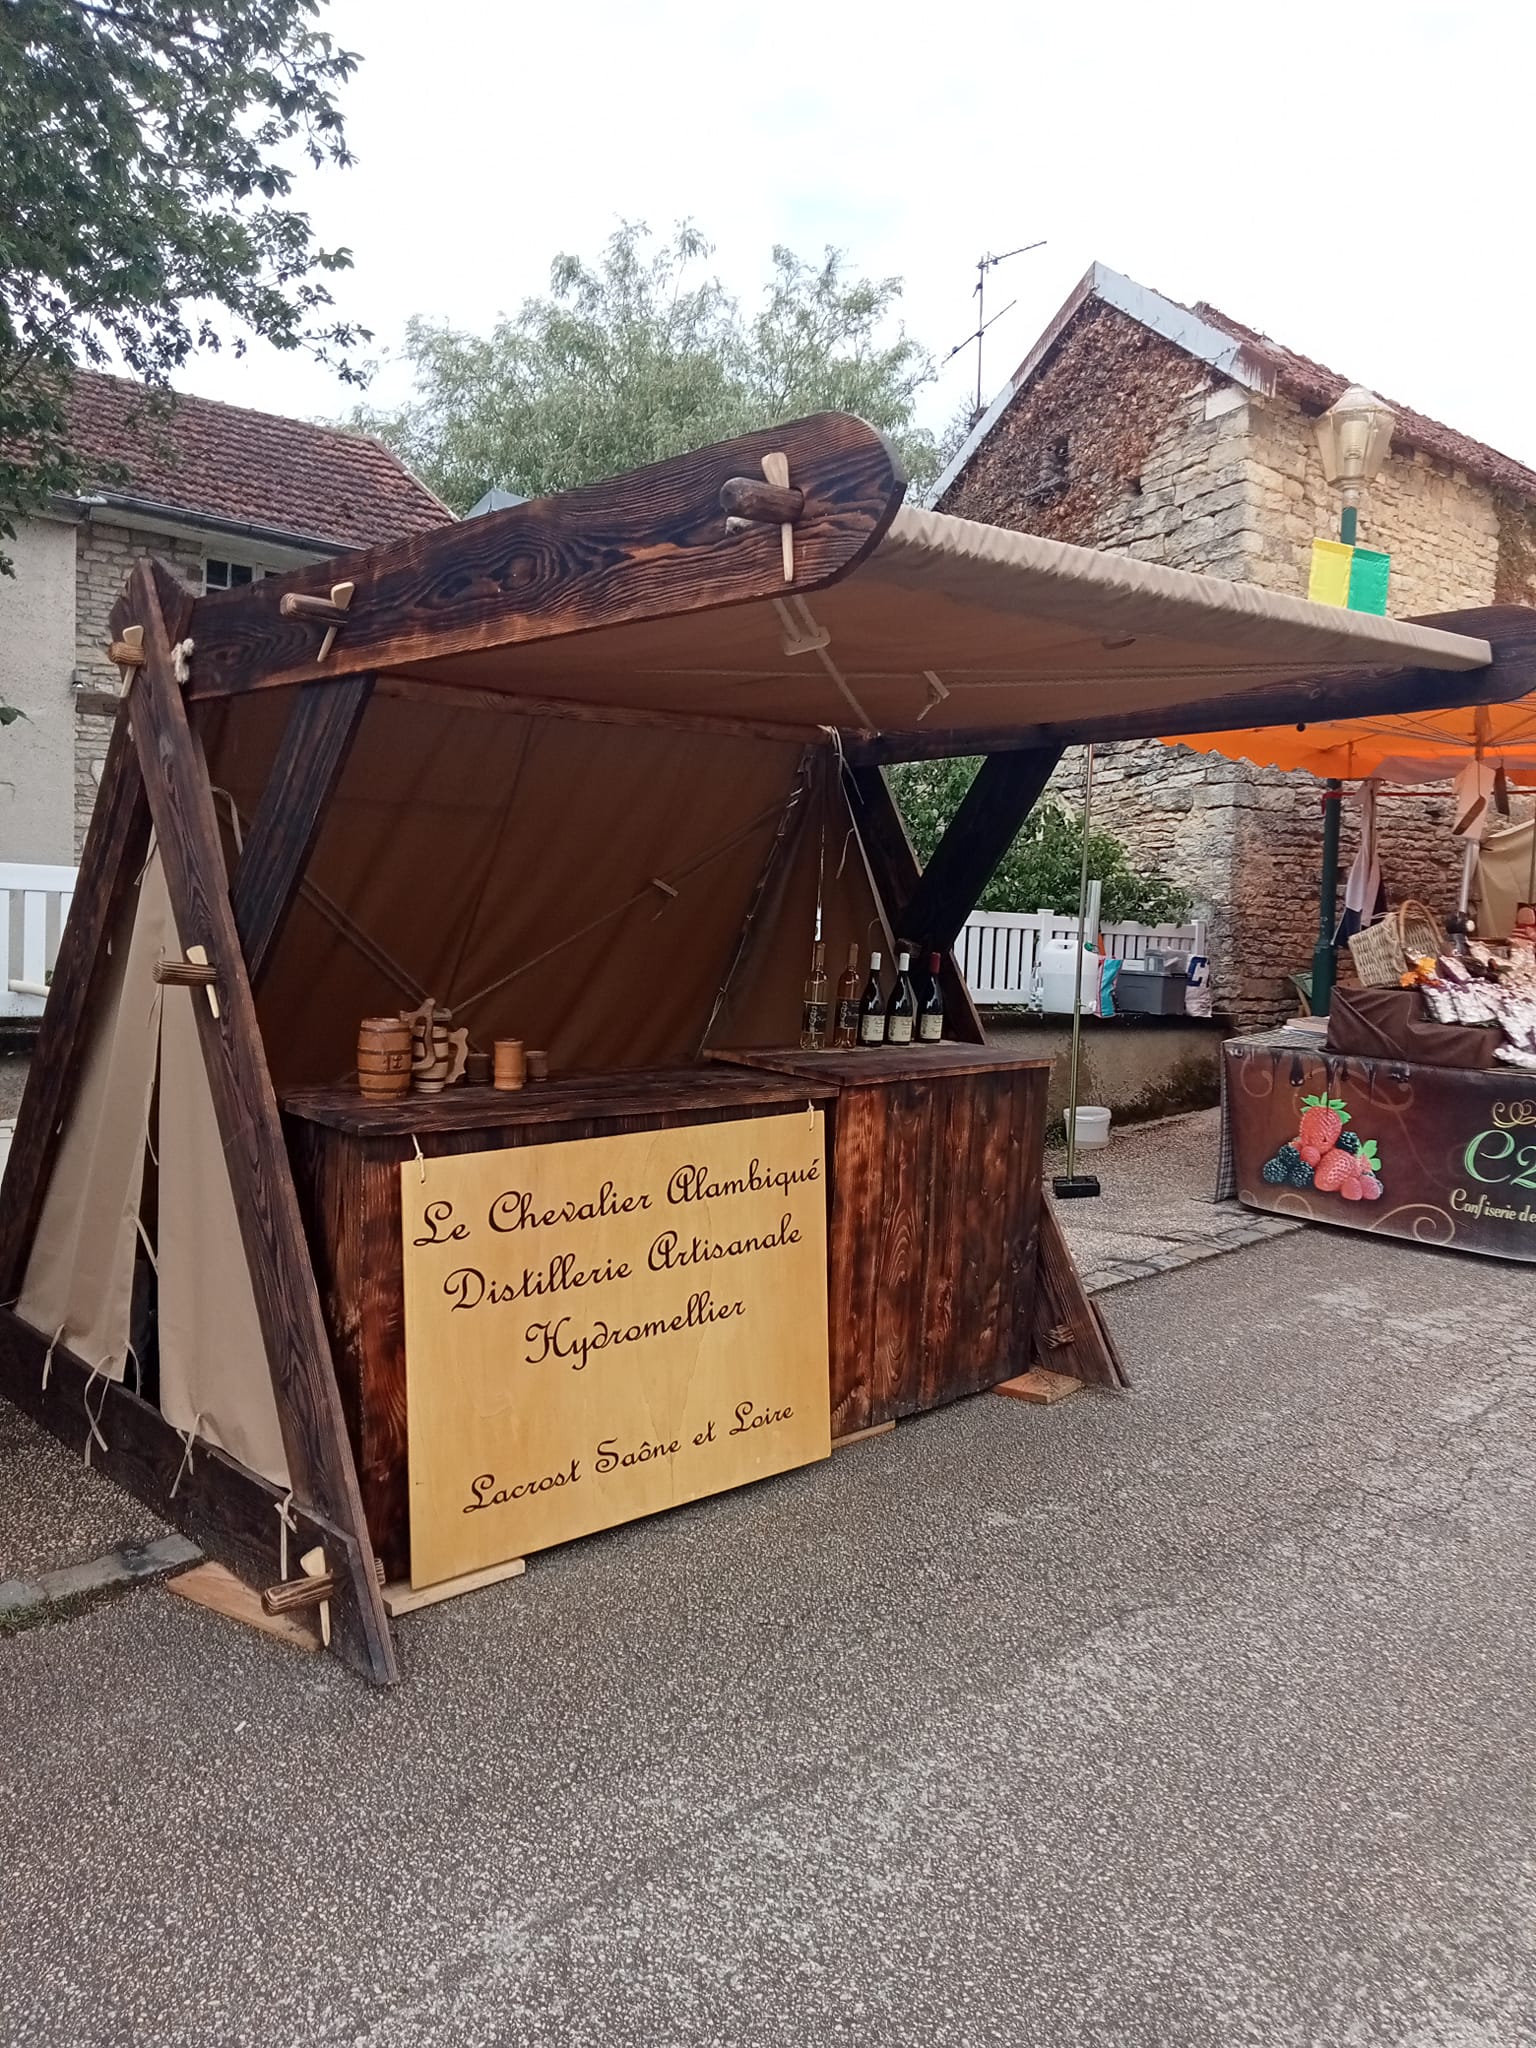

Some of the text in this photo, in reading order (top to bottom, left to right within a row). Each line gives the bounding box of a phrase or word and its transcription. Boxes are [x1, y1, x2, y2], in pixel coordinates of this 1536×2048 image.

[412, 1157, 821, 1247] Le Chevalier Alambiqué
[1450, 1188, 1517, 1220] Confiserie
[443, 1212, 803, 1312] Distillerie Artisanale
[524, 1290, 746, 1371] Hydromellier
[462, 1400, 794, 1514] Lacrost Saône et Loire
